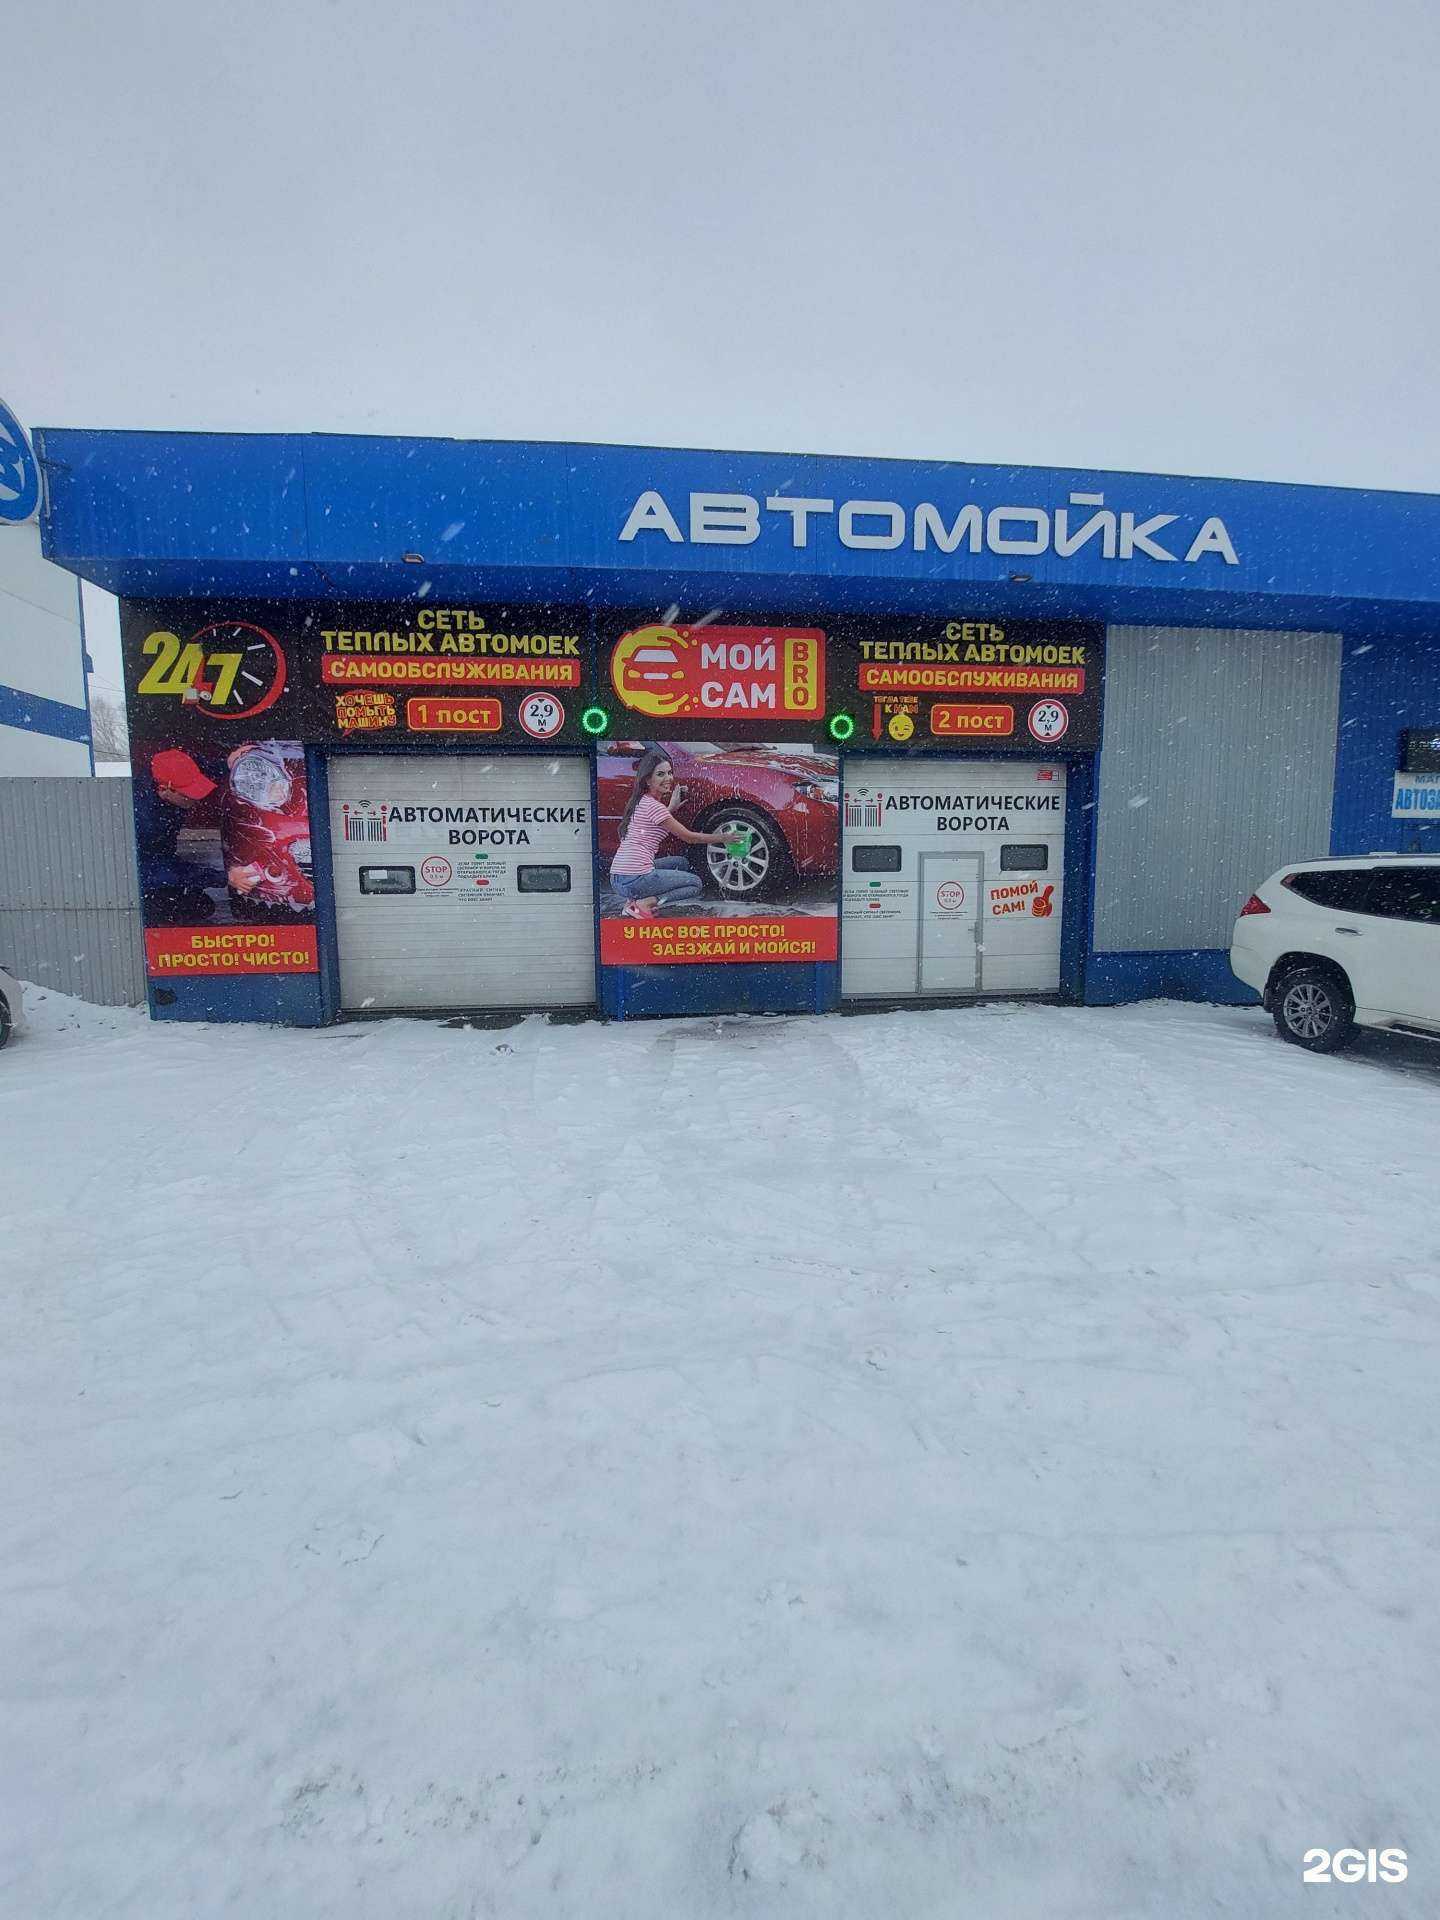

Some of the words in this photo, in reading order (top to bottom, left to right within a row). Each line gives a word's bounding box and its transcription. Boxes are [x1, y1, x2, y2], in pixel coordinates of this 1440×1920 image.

[618, 490, 1240, 565] АВТОМОЙКА
[417, 610, 485, 631] СЕТЬ
[946, 622, 1005, 641] СЕТЬ
[321, 630, 434, 652] ТЕПЛЫХ
[440, 632, 580, 655] АВТОМОЕК
[701, 637, 776, 671] МОЙ
[859, 641, 960, 661] ТЕПЛЫХ
[964, 643, 1086, 664] АВТОМОЕК
[330, 661, 573, 681] САМООБСЛУЖИВАНИЯ
[792, 641, 809, 706] BRO
[866, 669, 1078, 688] САМООБСЛУЖИВАНИЯ
[335, 693, 394, 706] ХОЧЕШЬ
[700, 681, 776, 709] САМ
[336, 705, 396, 718] ПОМЫТЬ
[417, 704, 429, 723] 1
[438, 708, 491, 724] пост
[530, 704, 554, 719] 2,9
[938, 711, 951, 728] 2
[957, 714, 1004, 728] пост
[1037, 710, 1059, 723] 2,9
[337, 715, 397, 728] МАШИНУ
[885, 796, 1060, 811] АВТОМАТИЧЕСКИЕ
[388, 806, 586, 823] АВТОМАТИЧЕСКИЕ
[937, 816, 1010, 831] ВОРОТА
[448, 829, 530, 845] ВОРОТА
[990, 880, 1039, 900] ПОМОЙ
[992, 900, 1026, 915] САМ!
[623, 926, 635, 939] У
[639, 926, 674, 939] НАС
[714, 924, 785, 938] ПРОСТО!
[191, 934, 275, 949] БЫСТРО!
[652, 939, 735, 956] ЗАЕЗЖАЙ
[739, 942, 749, 954] И
[754, 939, 816, 955] МОЙСЯ!
[158, 952, 239, 968] ПРОСТО!
[243, 951, 309, 966] ЧИСТО!
